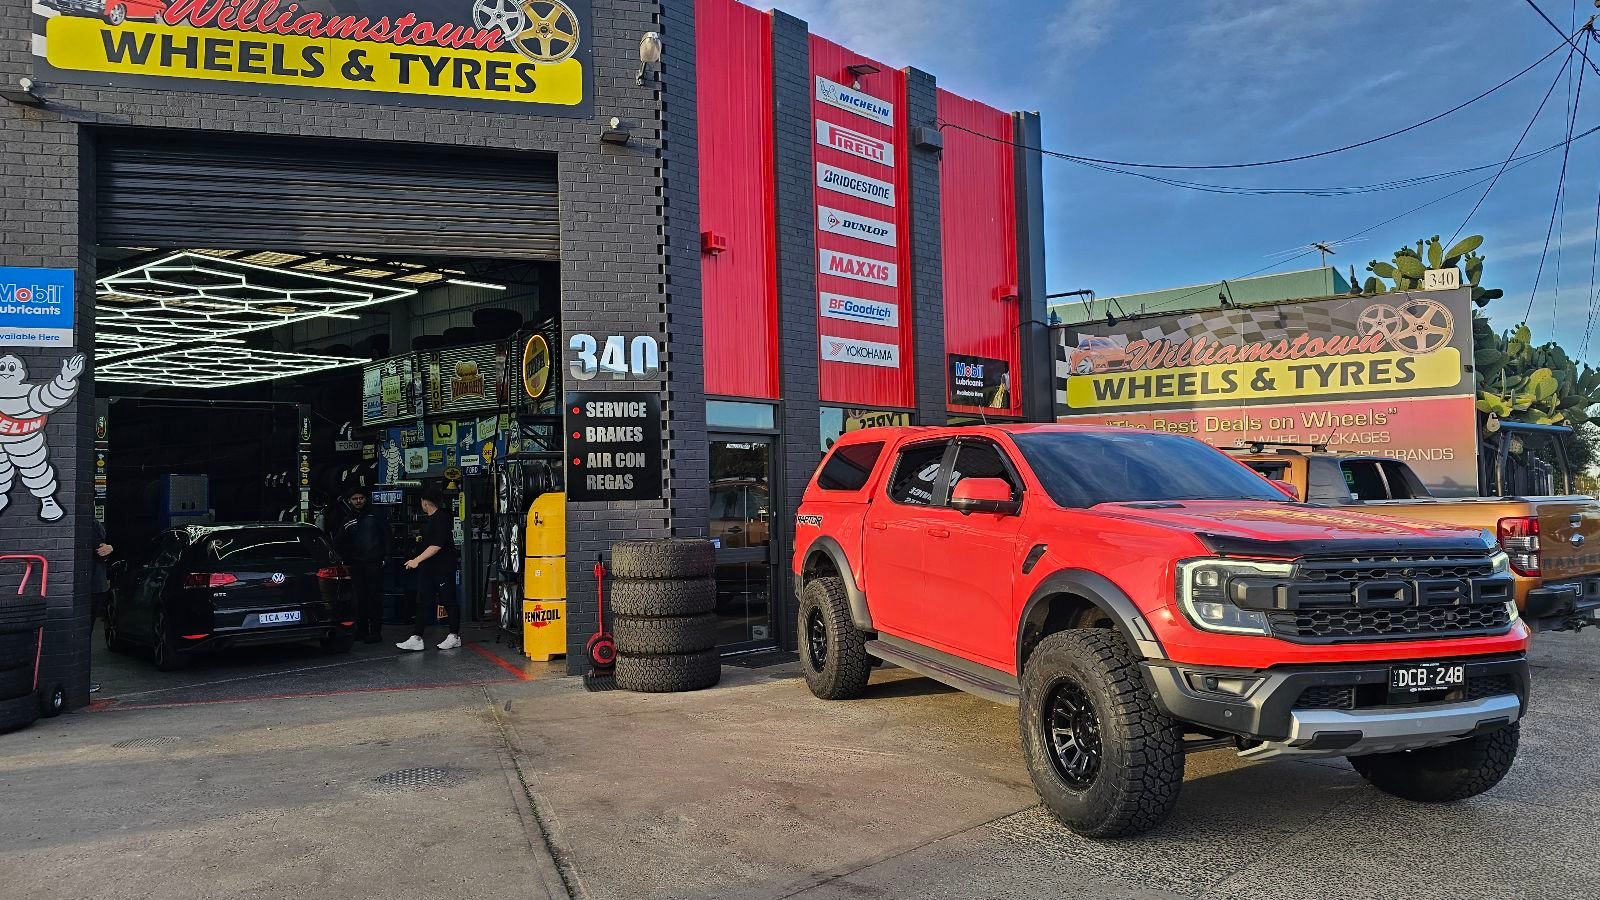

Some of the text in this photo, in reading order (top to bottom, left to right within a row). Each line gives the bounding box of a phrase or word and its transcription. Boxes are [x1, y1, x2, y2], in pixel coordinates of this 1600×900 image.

[163, 0, 505, 52] Williamstown
[100, 29, 537, 93] WHEELS & TYRES
[839, 92, 889, 117] MICHELIN
[829, 125, 884, 161] PIRELLI
[823, 169, 890, 200] BRIDGESTONE
[842, 219, 889, 237] DUNLOP
[829, 255, 889, 281] MAXXIS
[1429, 272, 1454, 288] 340
[0, 283, 61, 304] Mobil
[0, 304, 61, 315] ubricants
[828, 298, 891, 318] BFGoodrich
[0, 333, 60, 341] vailable Here
[569, 333, 659, 381] 340
[845, 344, 893, 361] YOKOHAMA
[1125, 331, 1387, 371] Williamstown
[955, 362, 984, 379] Mobil
[1093, 356, 1416, 401] WHEELS & TYRES
[955, 377, 984, 388] Lubricants
[585, 401, 647, 418] SERVICE
[0, 418, 42, 434] ELIN
[1153, 418, 1199, 433] Best
[1205, 416, 1262, 432] Deals
[1269, 415, 1295, 430] on
[585, 426, 644, 443] BRAKES
[1309, 432, 1391, 445] PACKAGES
[586, 451, 646, 469] AIR CON
[1385, 448, 1454, 460] BRANDS
[586, 474, 634, 490] REGAS
[1277, 578, 1515, 610] FORD
[524, 608, 561, 623] PENNZOIL
[1399, 666, 1463, 687] DCB 248
